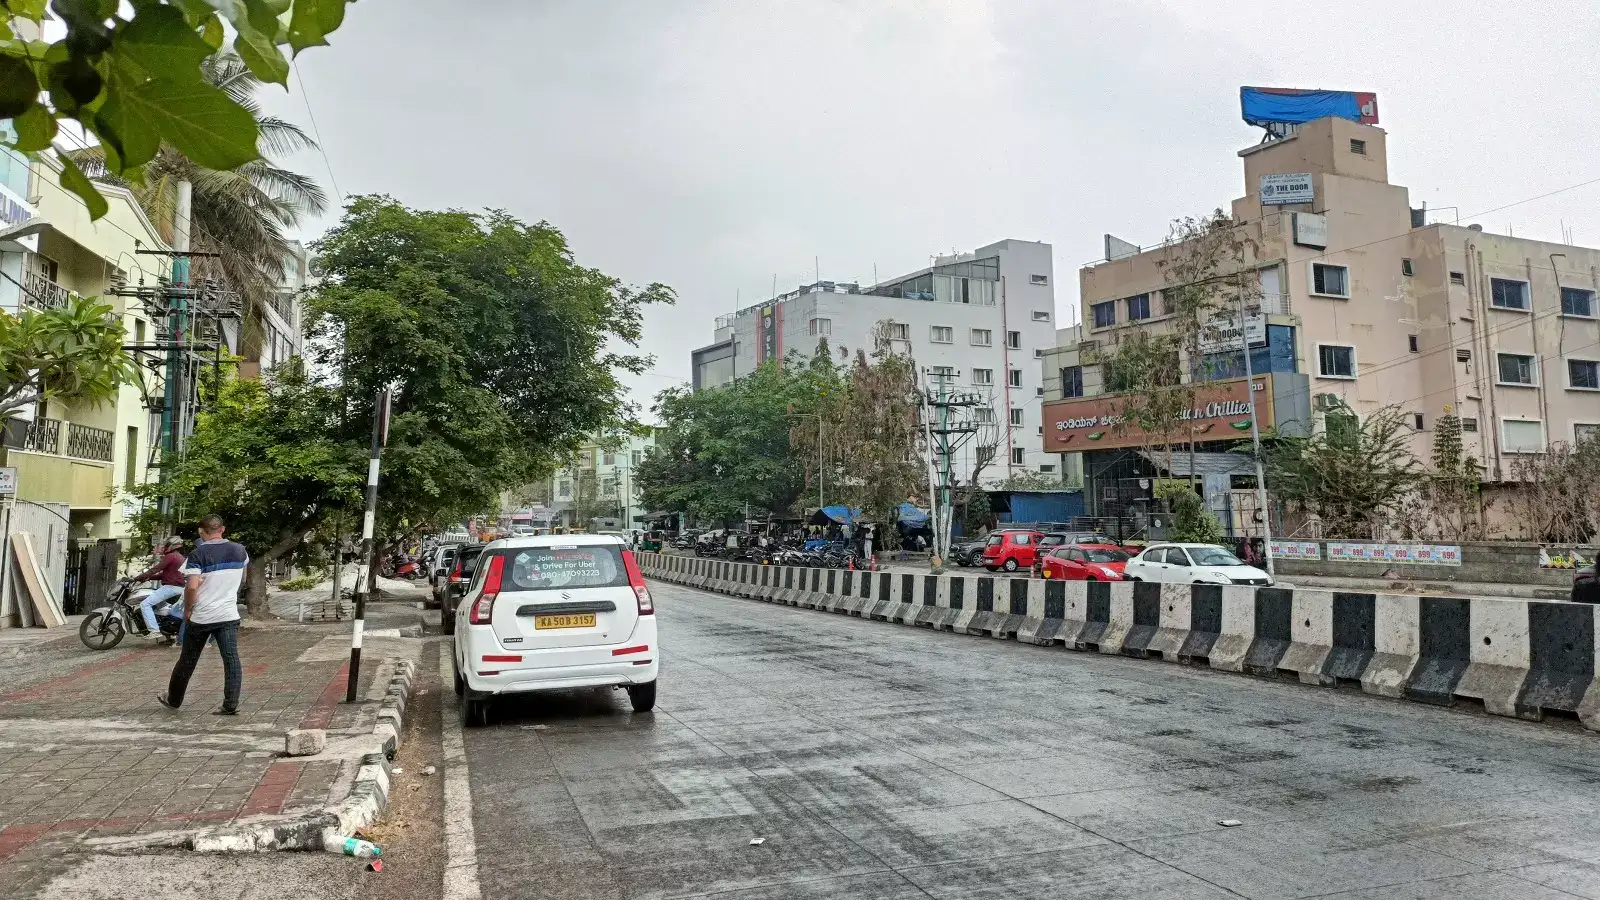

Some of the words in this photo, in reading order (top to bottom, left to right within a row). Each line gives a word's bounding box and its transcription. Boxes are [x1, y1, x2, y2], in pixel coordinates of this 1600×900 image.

[1206, 400, 1252, 418] Chillies
[578, 560, 596, 568] Uber
[541, 569, 600, 578] 080-47093223
[573, 614, 595, 625] 3157
